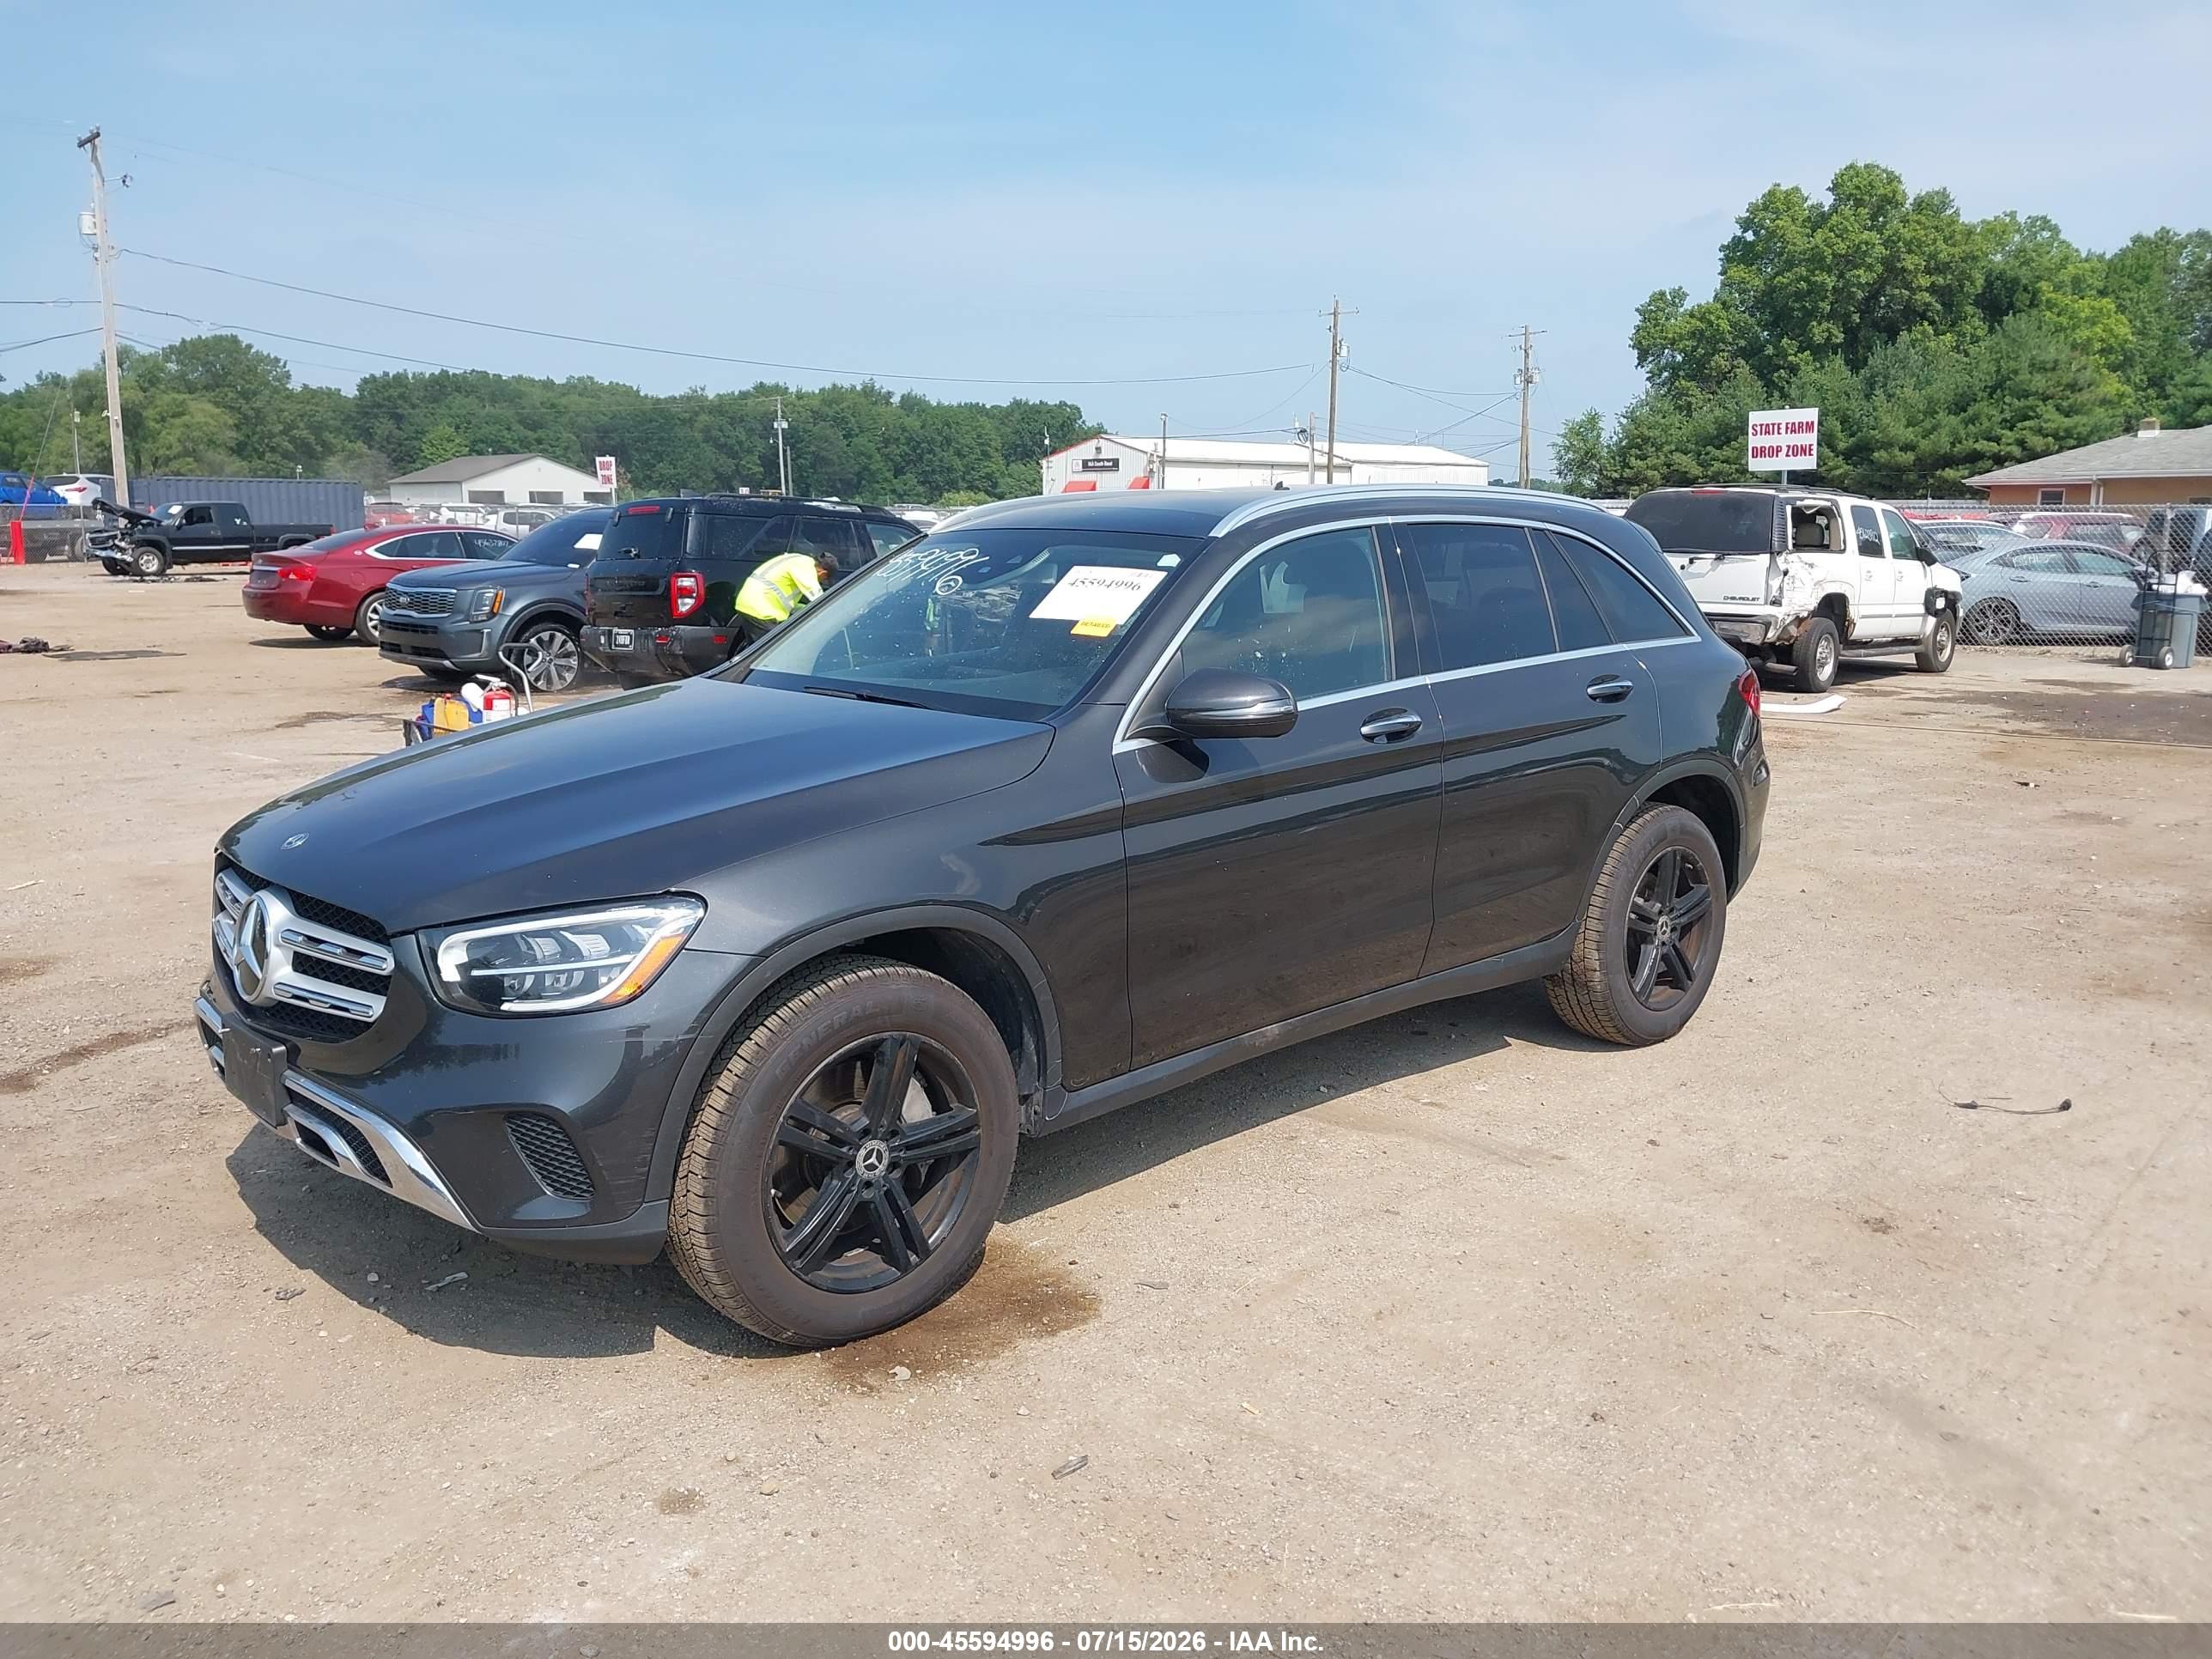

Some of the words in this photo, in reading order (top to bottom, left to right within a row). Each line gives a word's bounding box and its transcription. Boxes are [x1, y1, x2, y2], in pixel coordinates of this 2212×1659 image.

[1751, 422, 1783, 436] STATE
[1784, 420, 1814, 434] FARM
[1751, 445, 1783, 459] DROP
[1784, 443, 1814, 458] ZONE
[599, 459, 613, 471] DROP
[601, 474, 614, 485] ZONE
